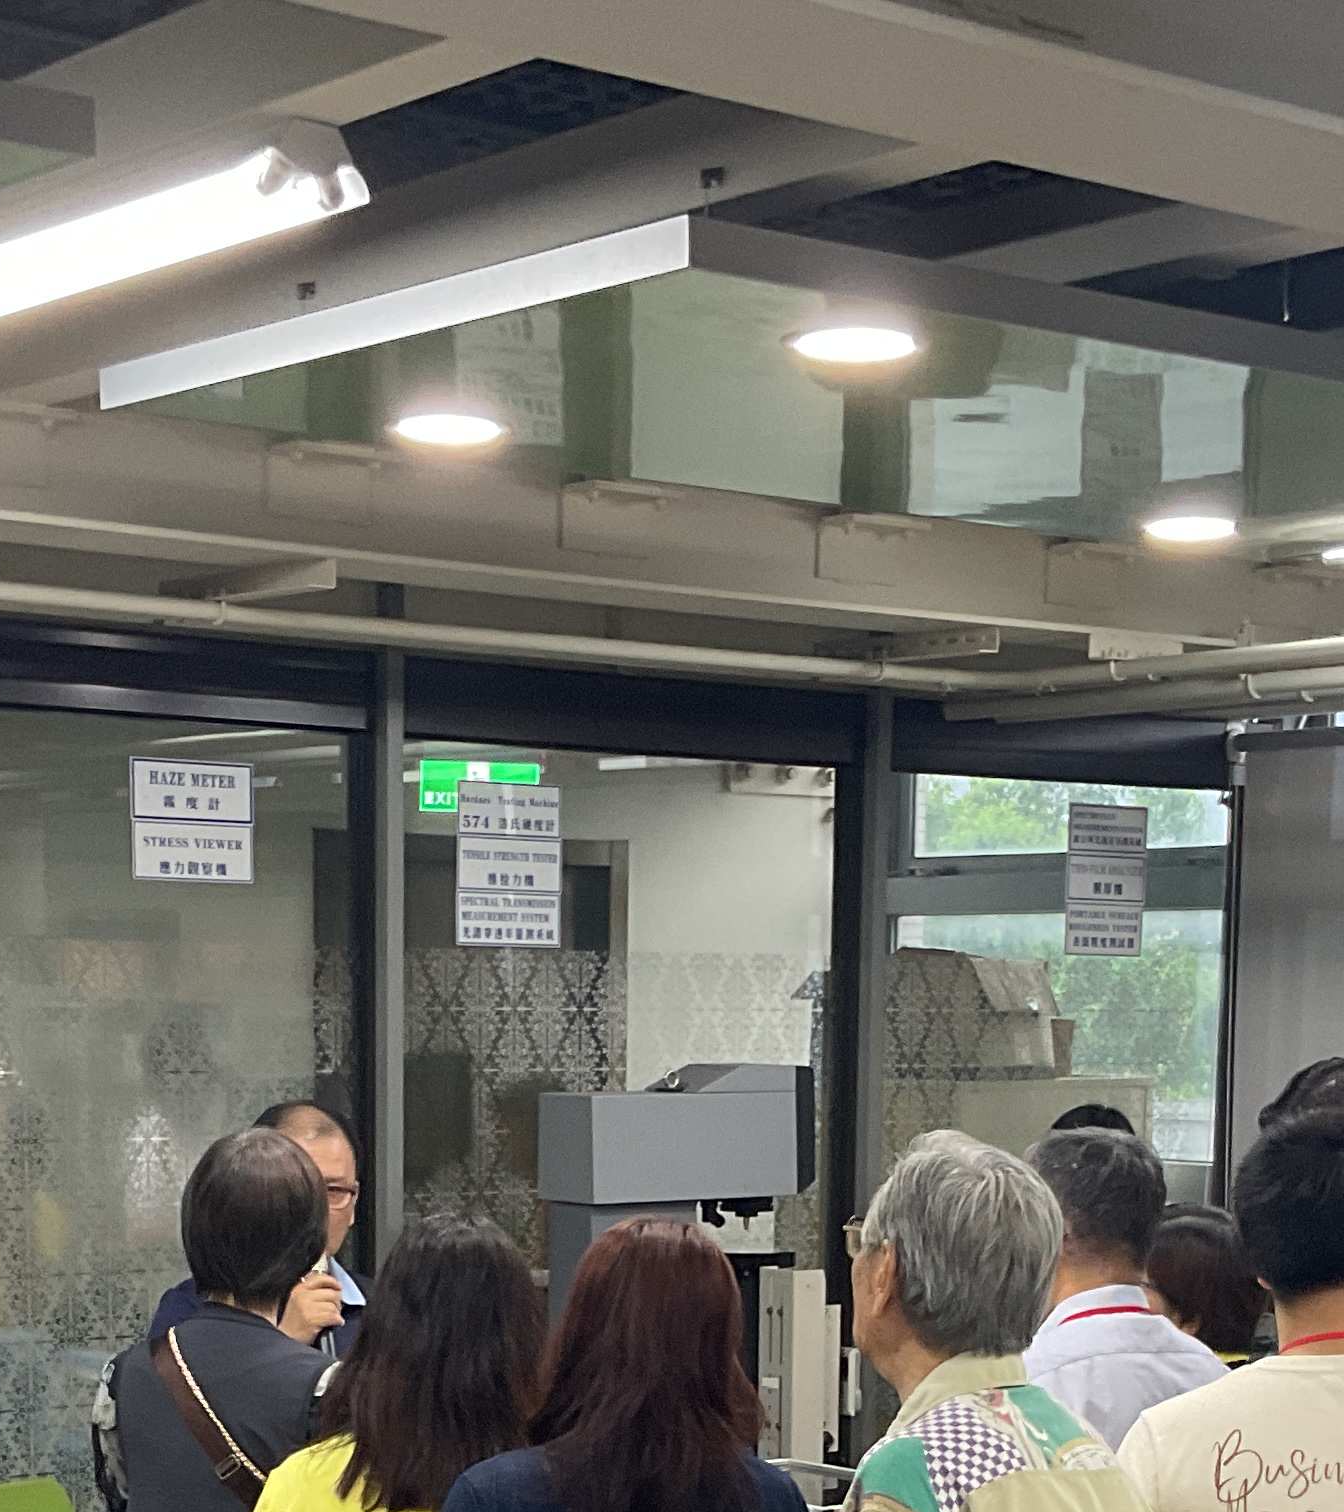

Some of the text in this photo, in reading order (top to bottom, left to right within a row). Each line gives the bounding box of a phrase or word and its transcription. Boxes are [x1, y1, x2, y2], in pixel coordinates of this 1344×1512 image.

[149, 770, 236, 789] HAZE METER
[462, 815, 490, 829] 574
[143, 836, 244, 851] STRESS VIEWER
